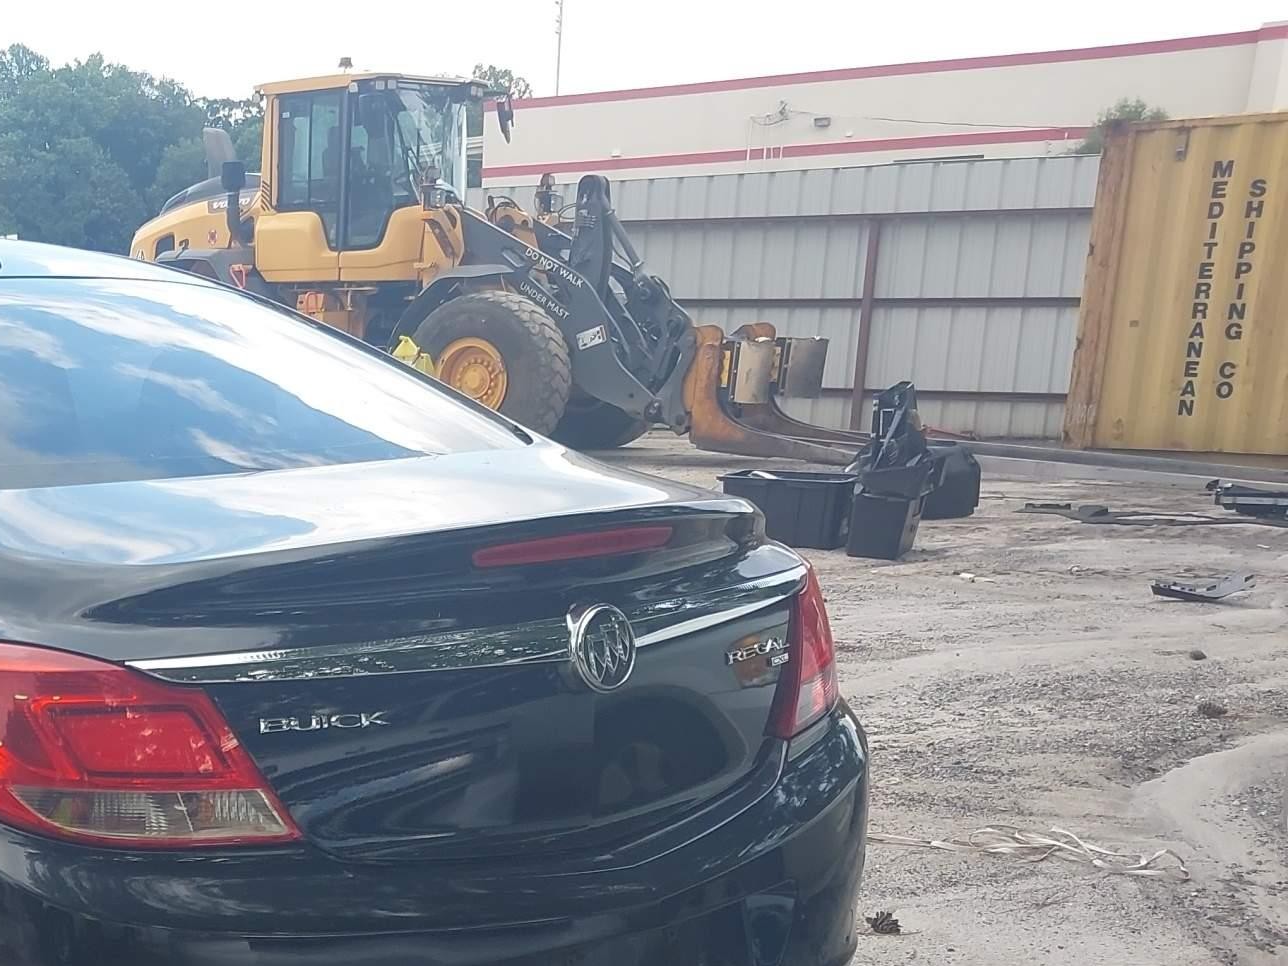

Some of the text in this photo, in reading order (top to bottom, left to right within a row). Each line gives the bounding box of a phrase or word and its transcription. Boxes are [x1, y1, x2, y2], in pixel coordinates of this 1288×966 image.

[213, 198, 251, 209] VOO
[525, 248, 584, 288] DO NOT WALK
[520, 281, 570, 320] UNDER MAST
[1177, 159, 1234, 417] MEDITERRANEAN
[1215, 179, 1267, 399] SHIPPING CO
[727, 638, 790, 665] REGAL
[259, 710, 392, 734] BUICK
